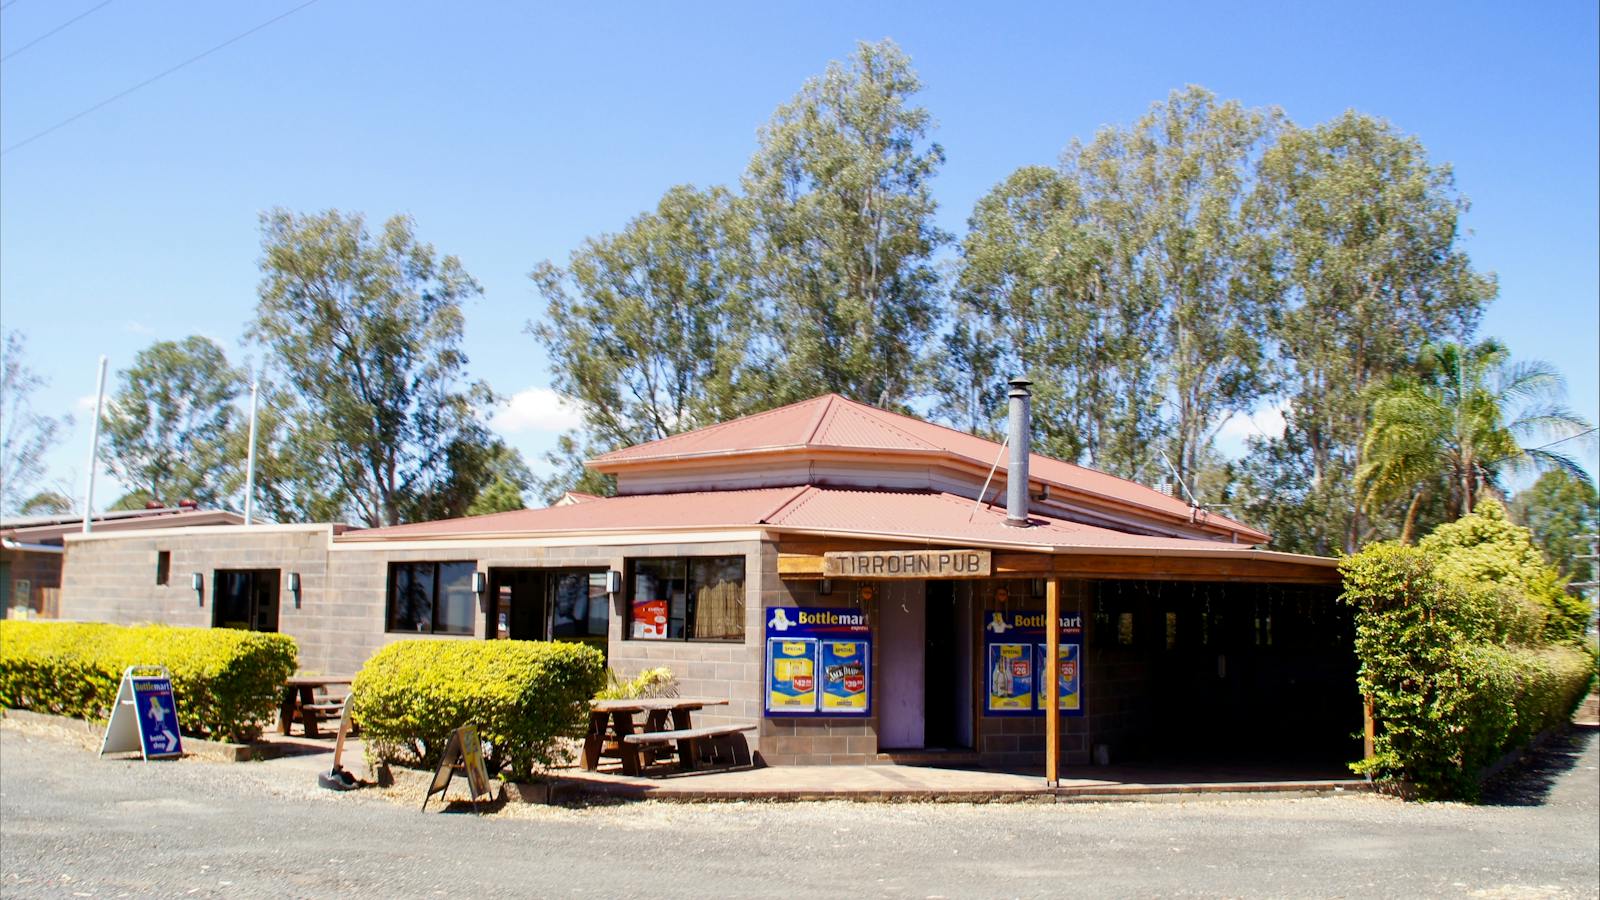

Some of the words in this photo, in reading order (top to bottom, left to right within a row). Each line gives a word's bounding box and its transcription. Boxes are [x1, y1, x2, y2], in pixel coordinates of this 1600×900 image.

[836, 554, 931, 574] TIRROAN
[938, 554, 980, 573] PUB
[798, 611, 869, 625] Bottlemart
[135, 682, 170, 691] Bottlemart
